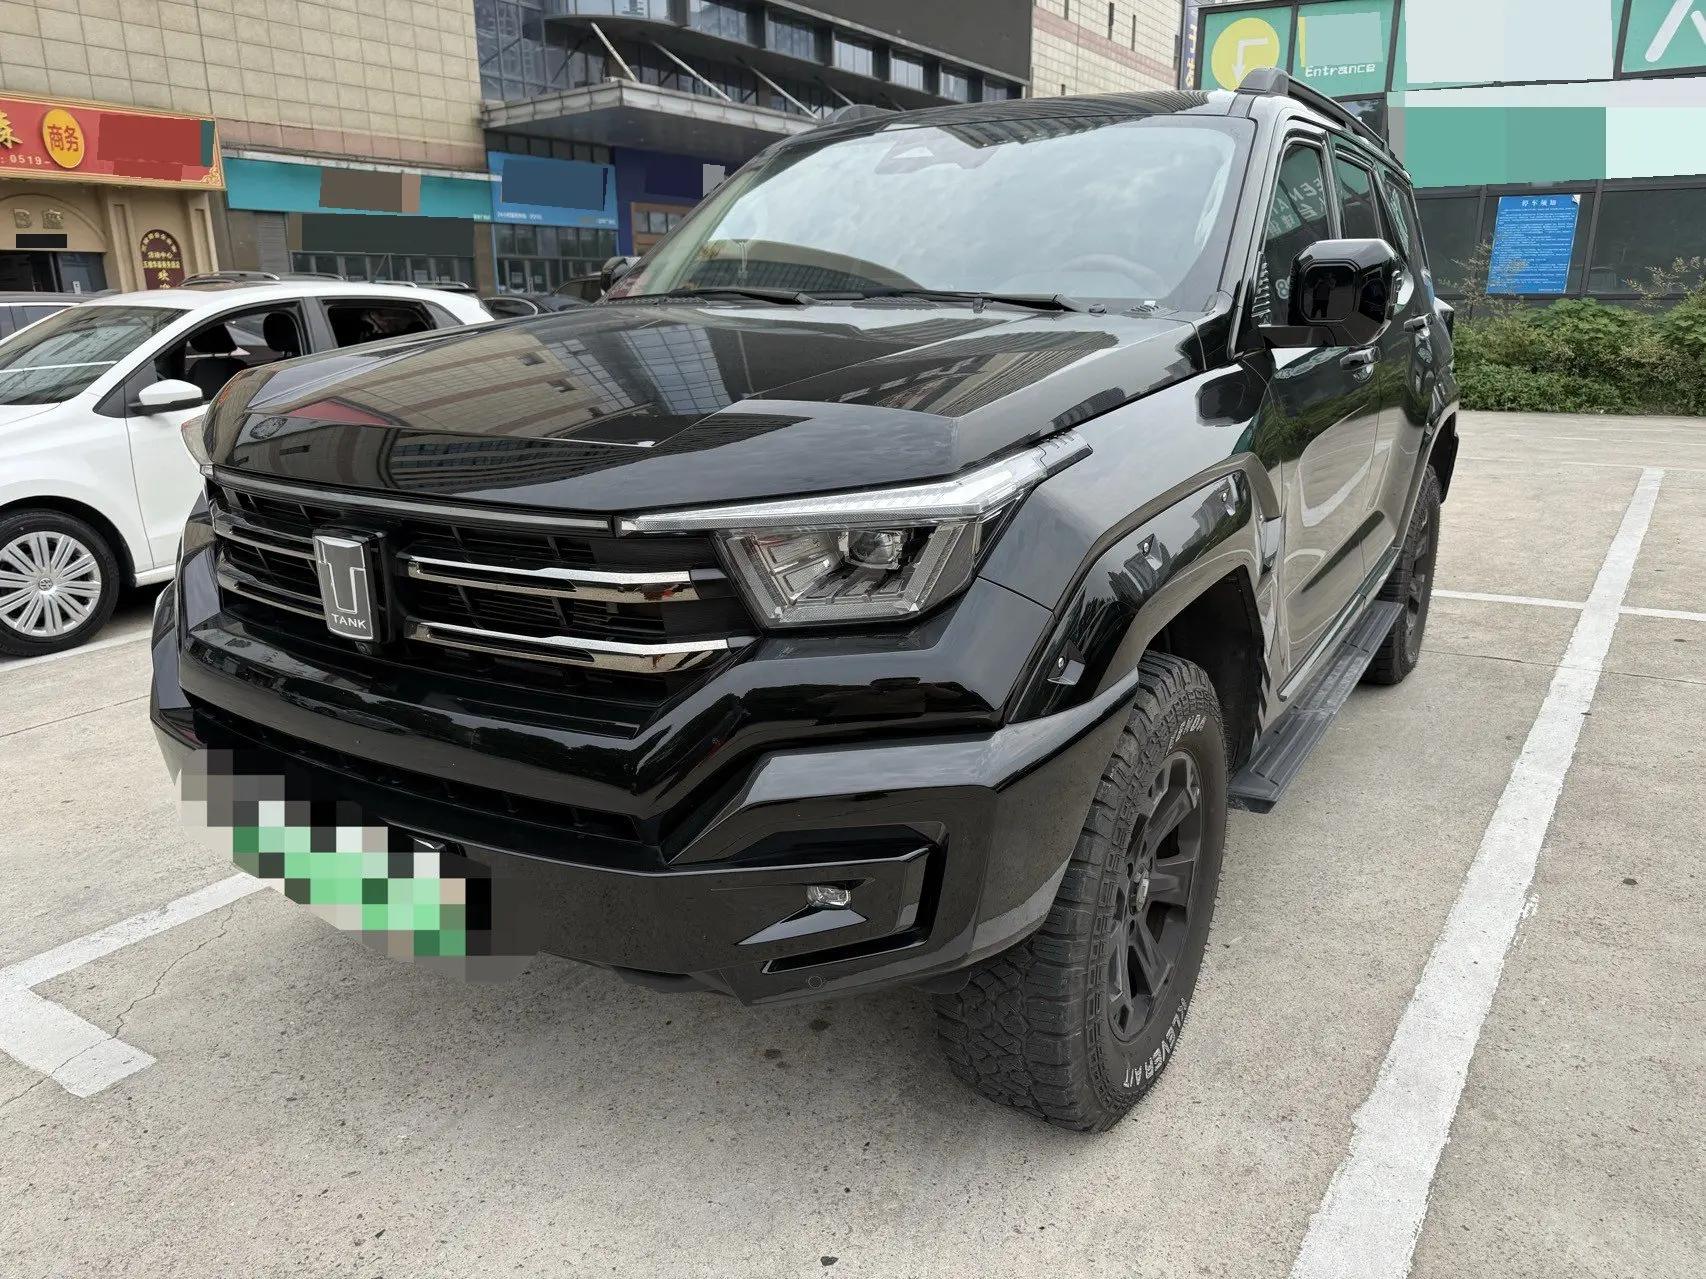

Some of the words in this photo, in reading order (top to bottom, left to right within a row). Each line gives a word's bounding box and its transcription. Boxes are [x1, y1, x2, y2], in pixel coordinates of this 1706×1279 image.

[1305, 63, 1376, 78] Entrance
[47, 123, 80, 153] 商务
[331, 613, 366, 630] TANK
[1144, 997, 1188, 1080] KLEVER
